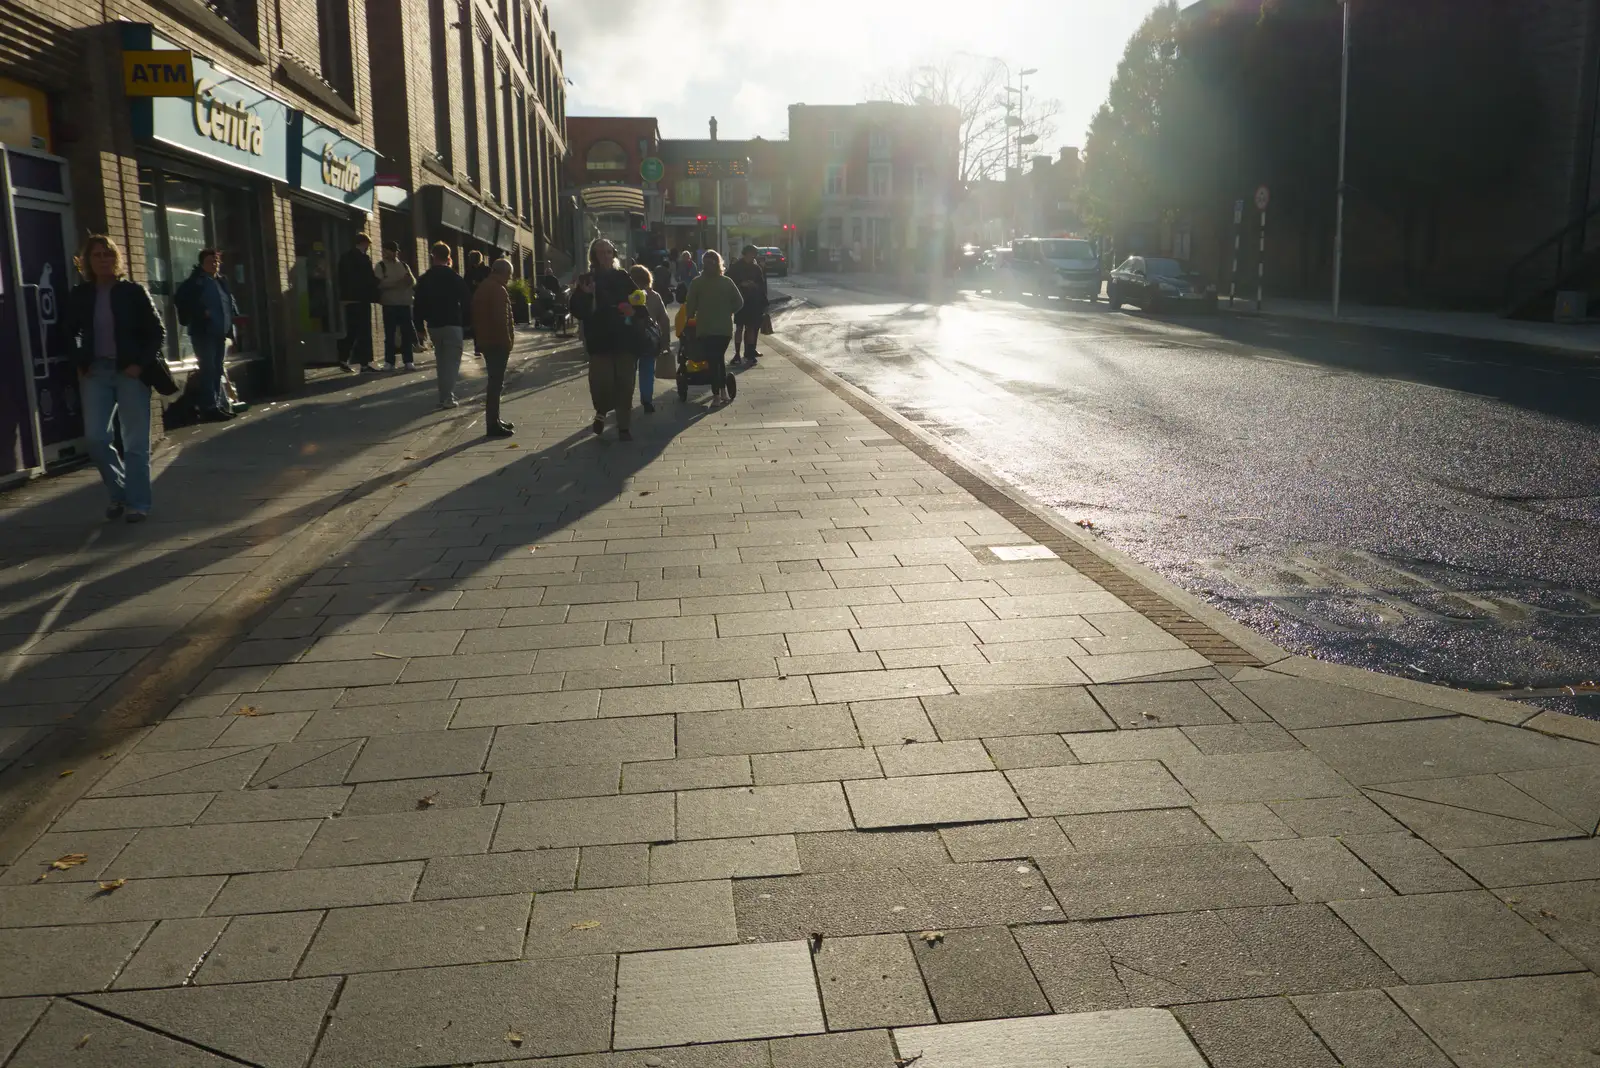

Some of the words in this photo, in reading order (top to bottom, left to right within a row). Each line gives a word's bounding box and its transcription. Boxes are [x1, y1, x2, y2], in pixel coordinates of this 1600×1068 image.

[131, 63, 188, 84] ATM
[195, 77, 264, 156] Centra
[322, 142, 361, 193] Centra
